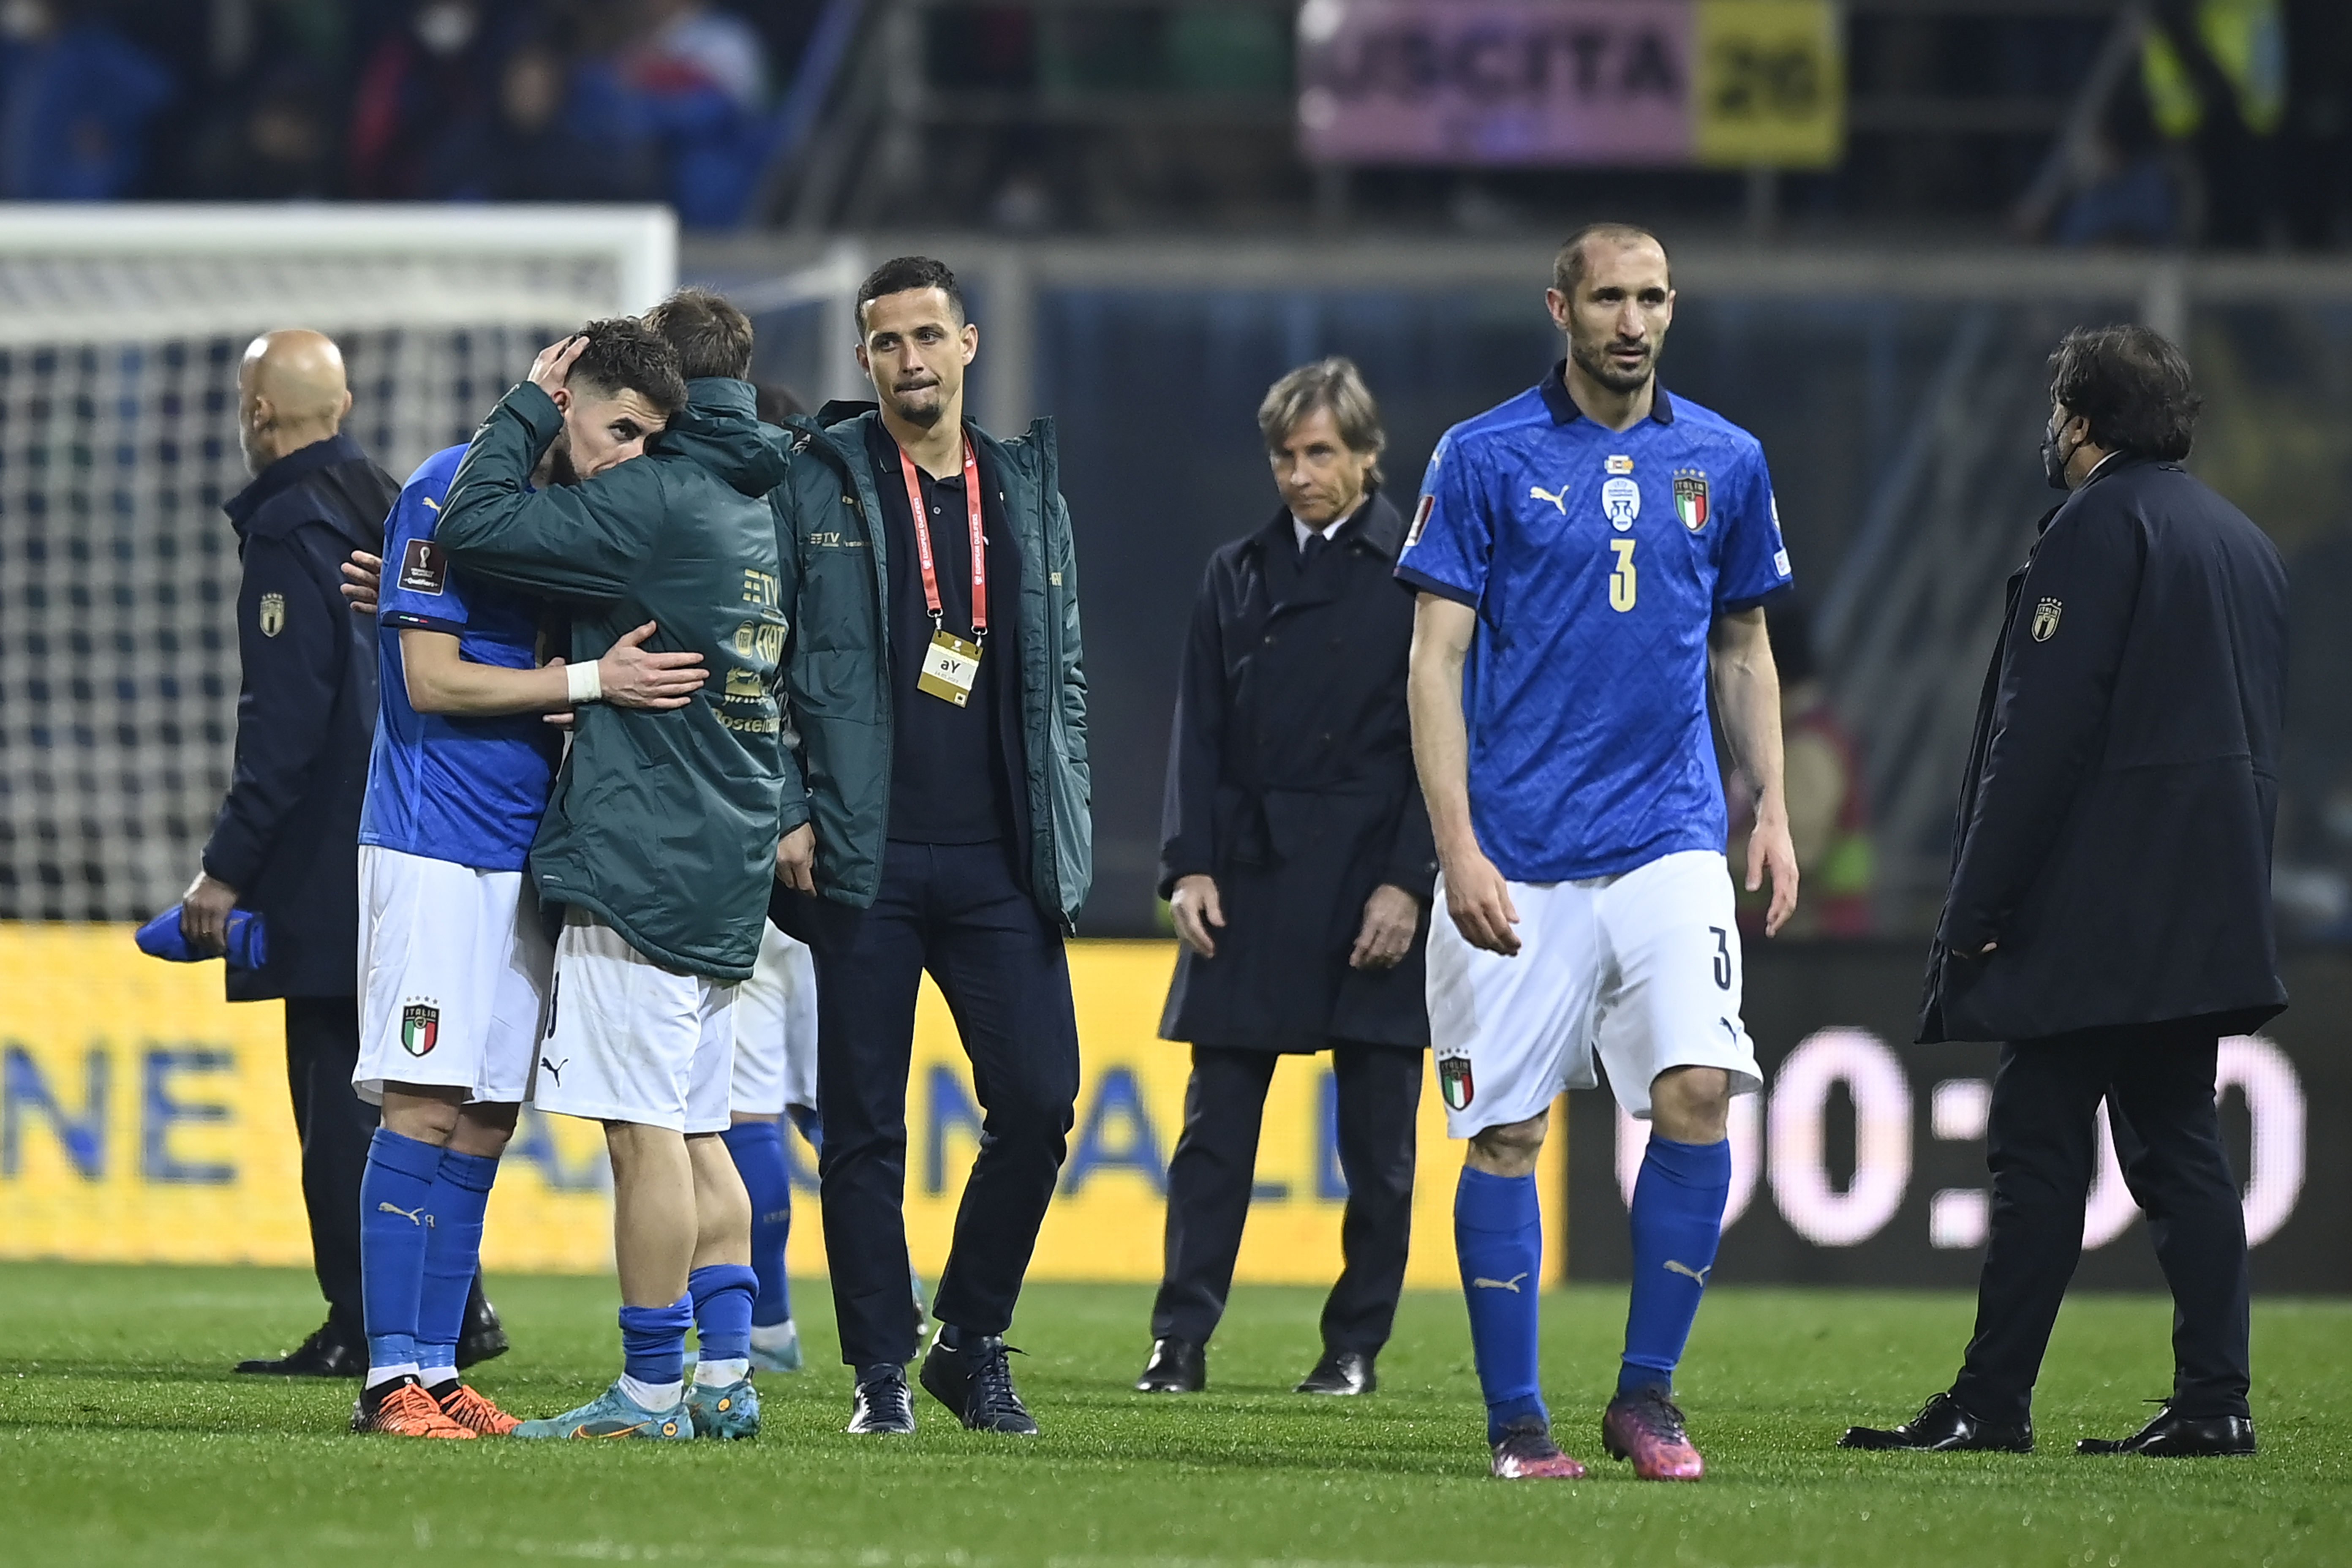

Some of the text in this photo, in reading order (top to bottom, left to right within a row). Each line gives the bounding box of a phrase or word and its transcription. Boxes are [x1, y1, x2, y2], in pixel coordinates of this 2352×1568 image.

[1675, 481, 1704, 490] ITALIA
[1609, 539, 1636, 612] 3
[941, 660, 961, 673] aY
[1709, 926, 1731, 990] 3
[406, 1008, 436, 1018] ITALIA
